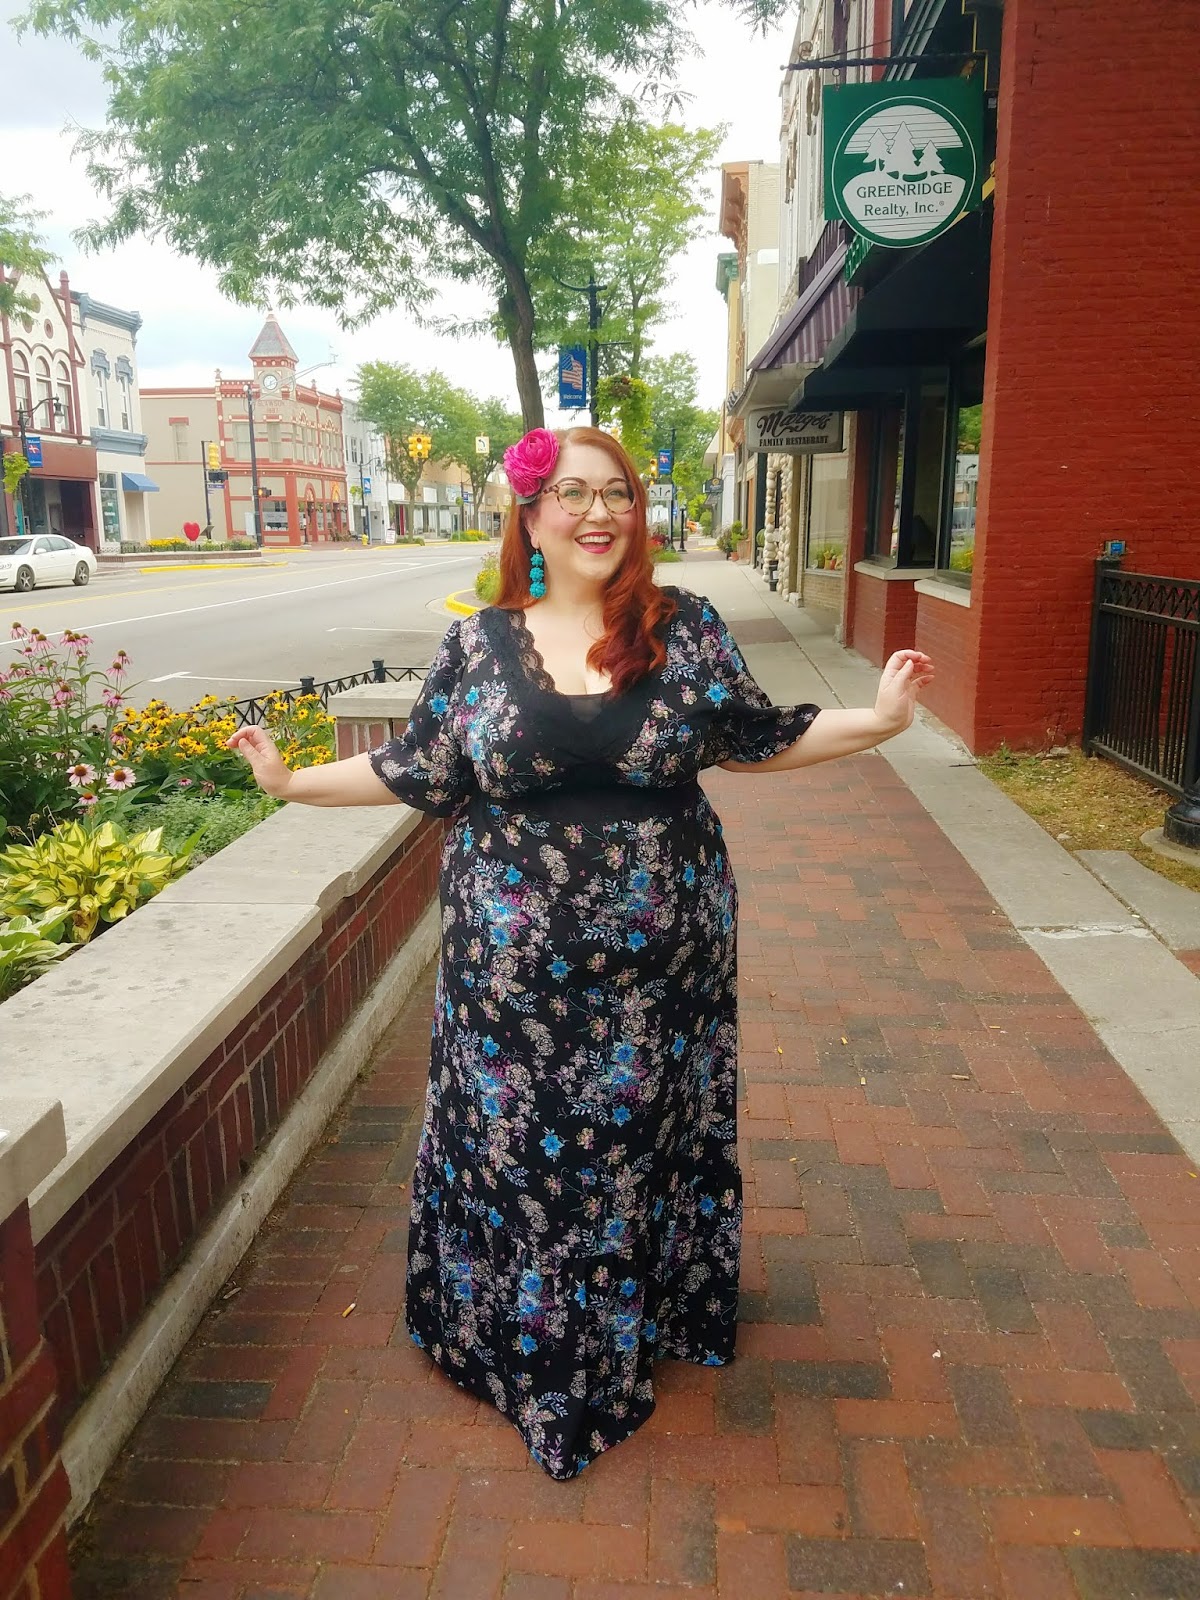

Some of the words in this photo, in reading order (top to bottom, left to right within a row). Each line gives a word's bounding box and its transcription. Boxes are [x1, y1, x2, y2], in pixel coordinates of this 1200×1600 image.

[856, 182, 953, 198] GREENRIDGE
[864, 203, 909, 217] Realty,
[759, 438, 784, 447] FAMILY
[786, 435, 829, 446] RESTAURANT
